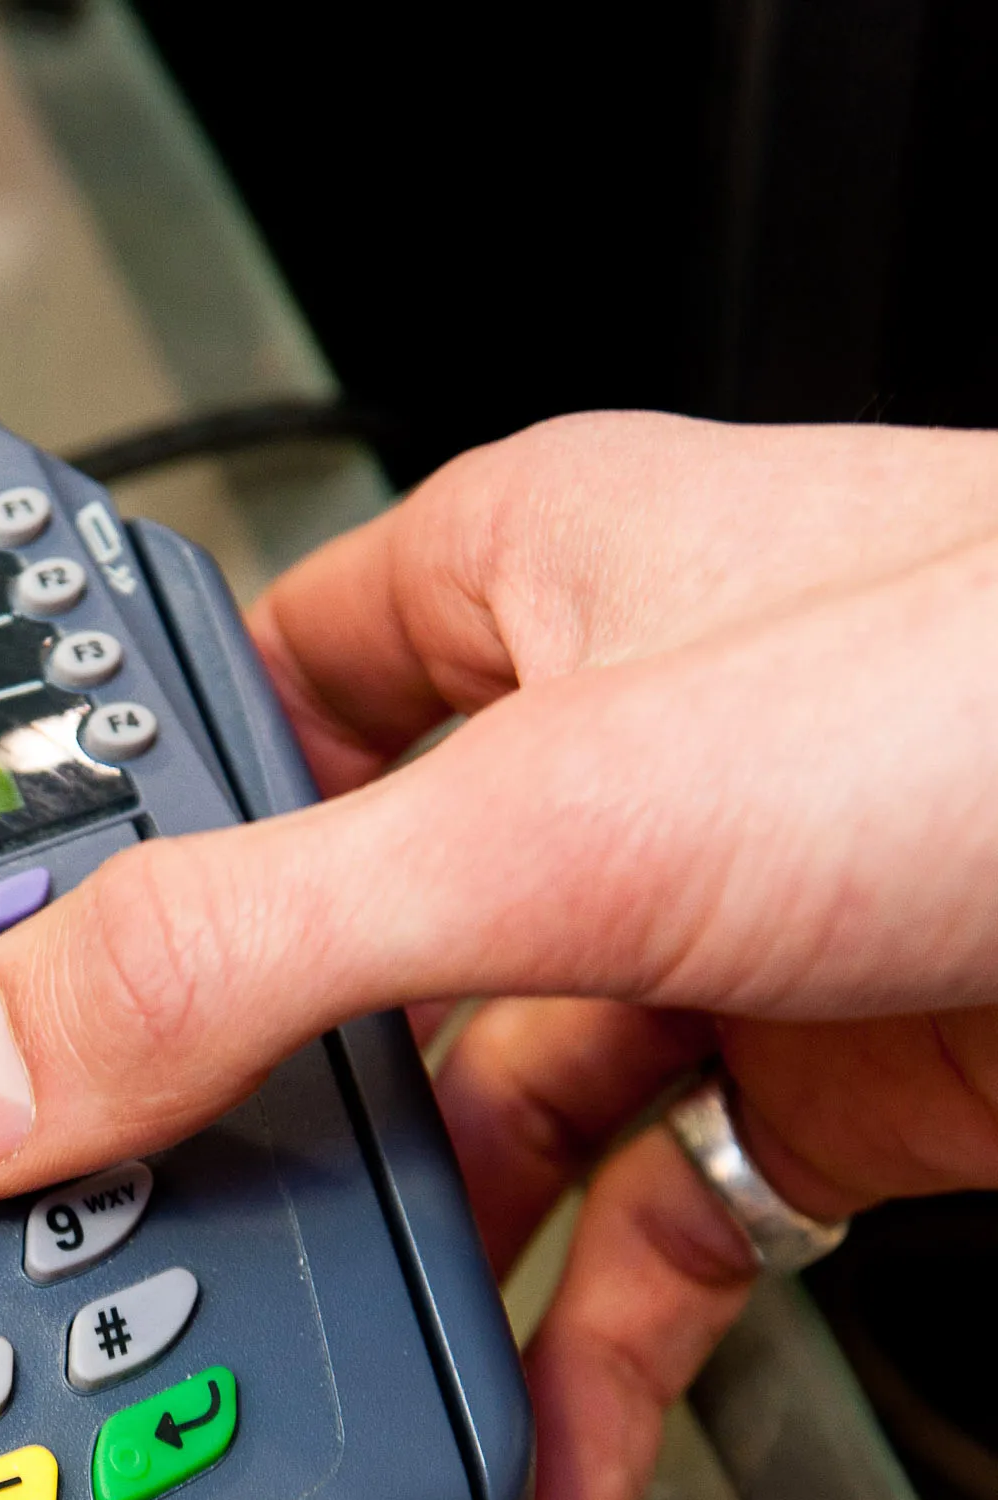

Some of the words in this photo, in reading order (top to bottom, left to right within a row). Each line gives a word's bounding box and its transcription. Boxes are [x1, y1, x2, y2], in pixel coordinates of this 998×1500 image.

[2, 497, 34, 519] F1
[37, 565, 69, 589] F2
[72, 640, 106, 663] F3
[107, 710, 141, 734] F4
[45, 1204, 85, 1252] 9
[82, 1181, 137, 1215] WXY
